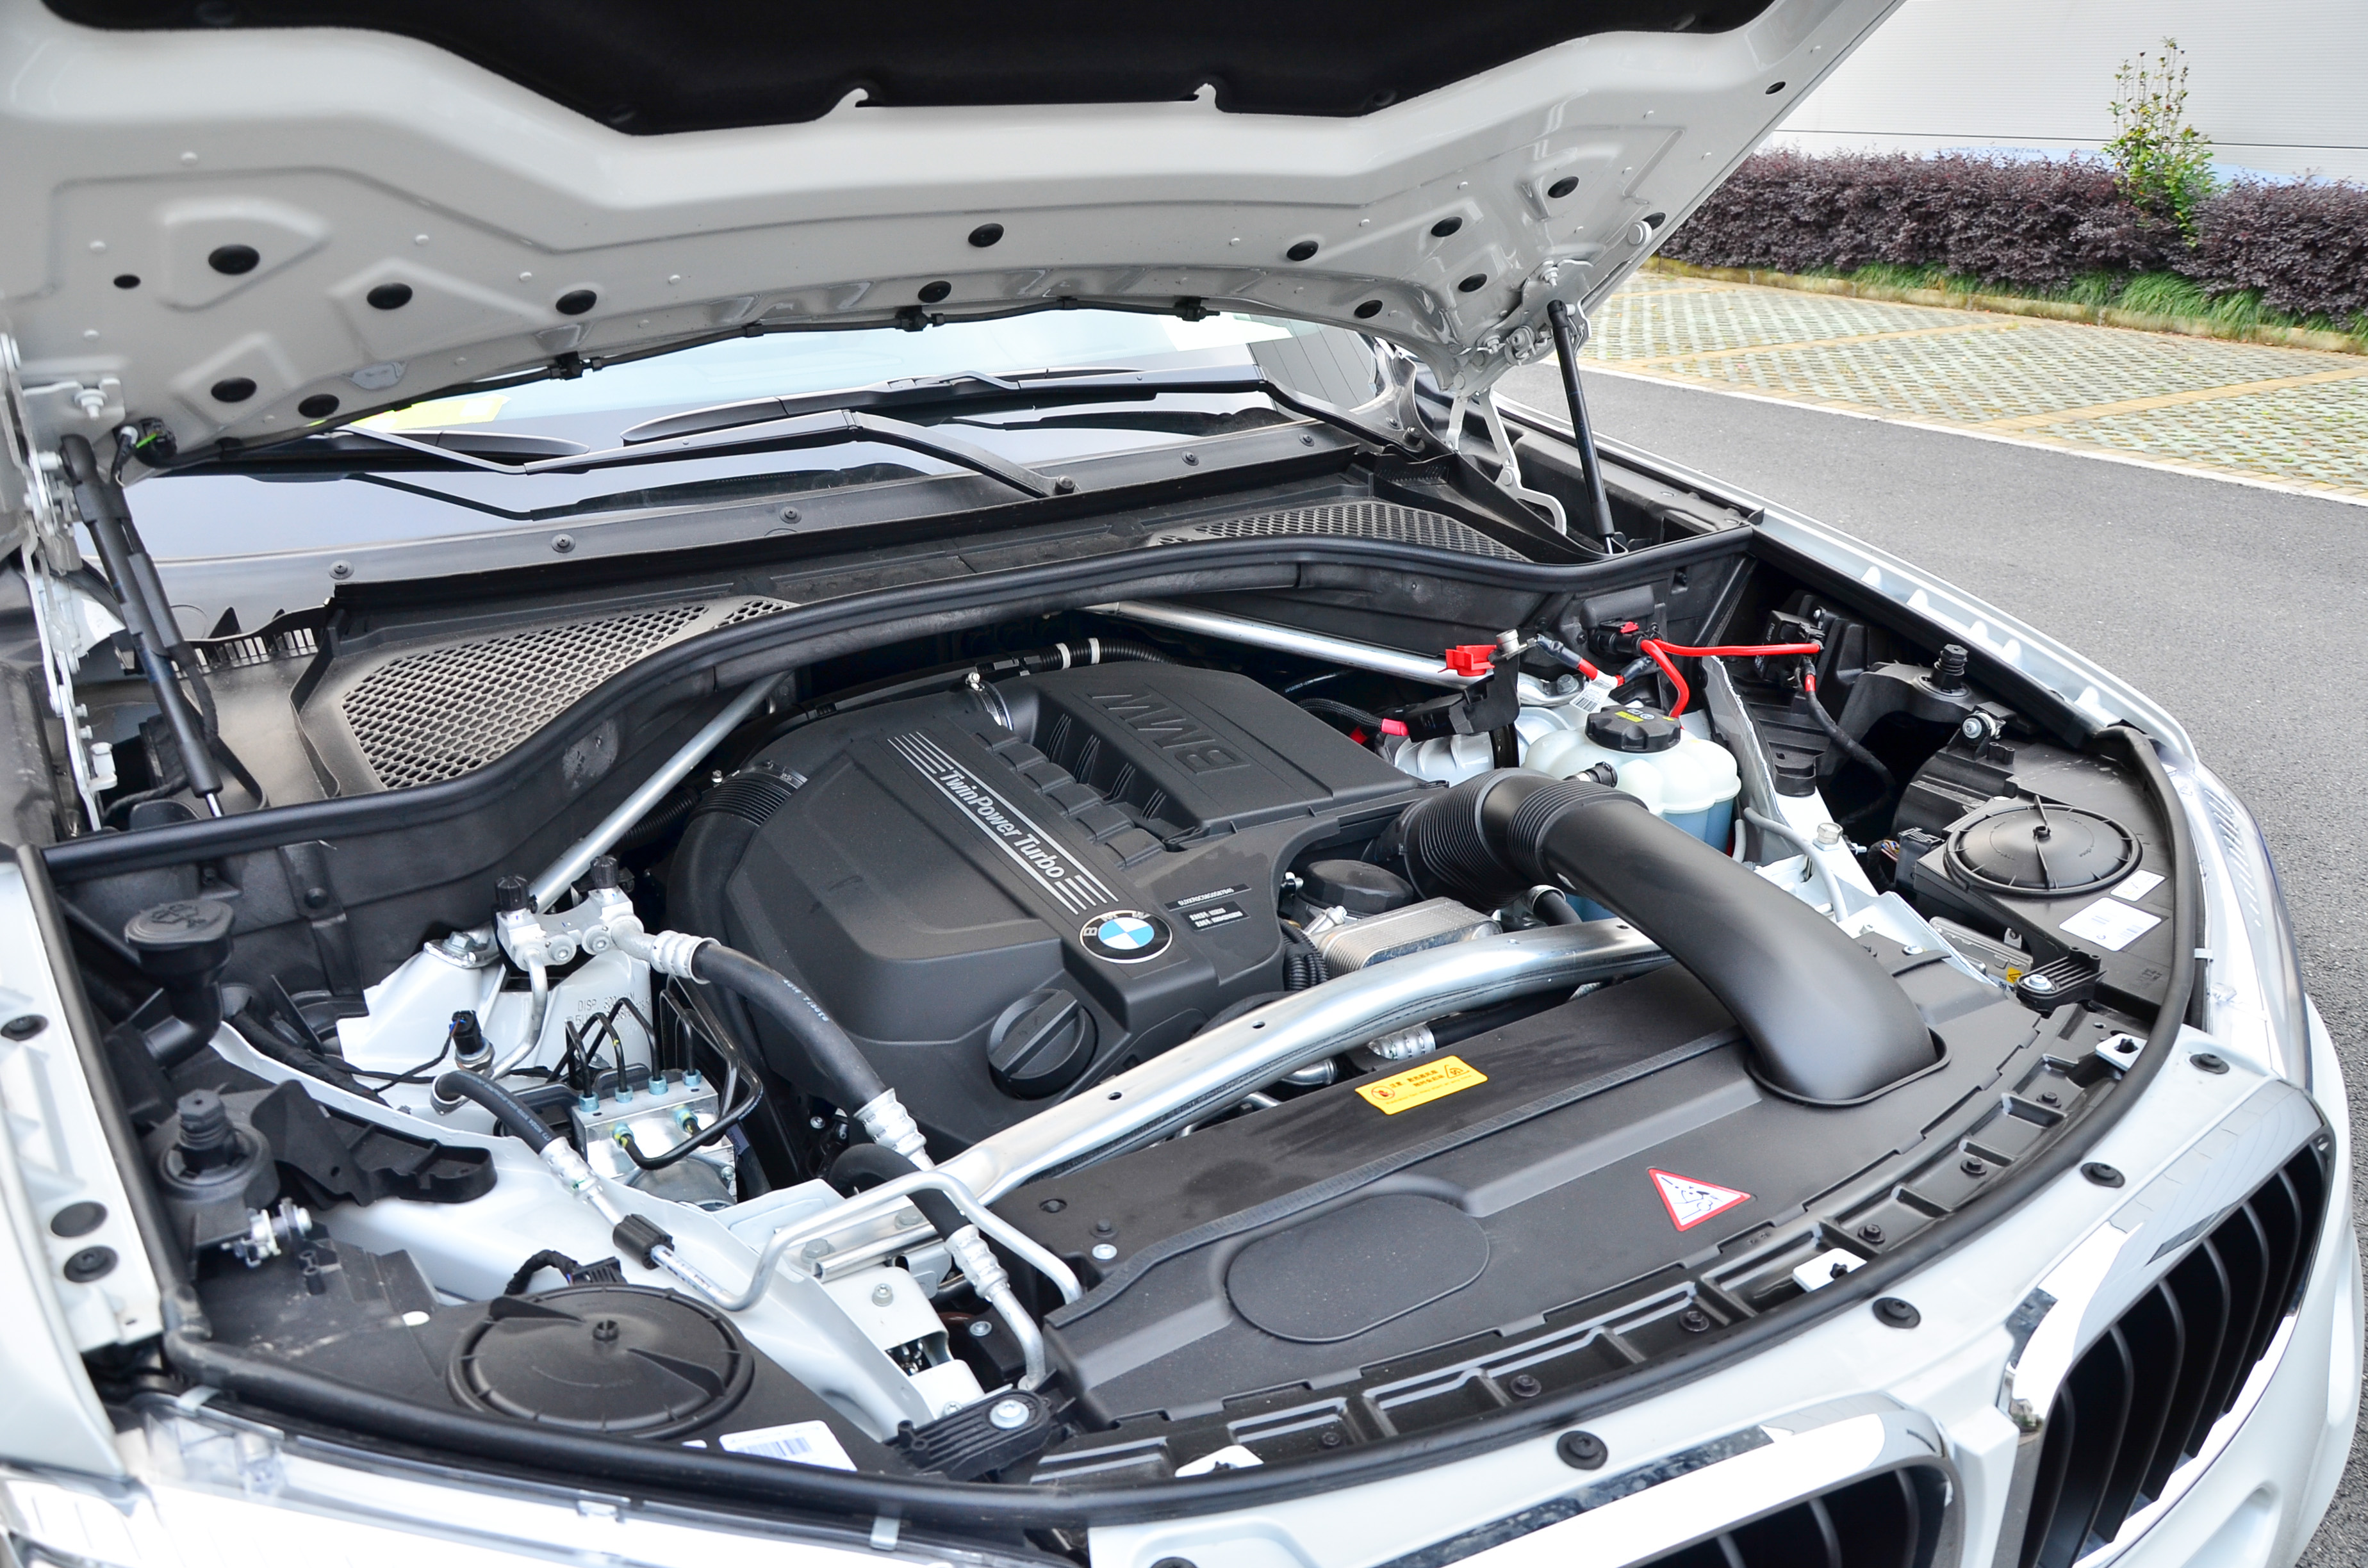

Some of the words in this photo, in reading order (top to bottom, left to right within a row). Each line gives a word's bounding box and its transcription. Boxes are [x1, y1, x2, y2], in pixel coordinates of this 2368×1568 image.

[1087, 693, 1251, 774] BMW
[940, 768, 1023, 837] TwinPower
[1014, 833, 1065, 878] Turbo
[1083, 911, 1151, 936] BMW
